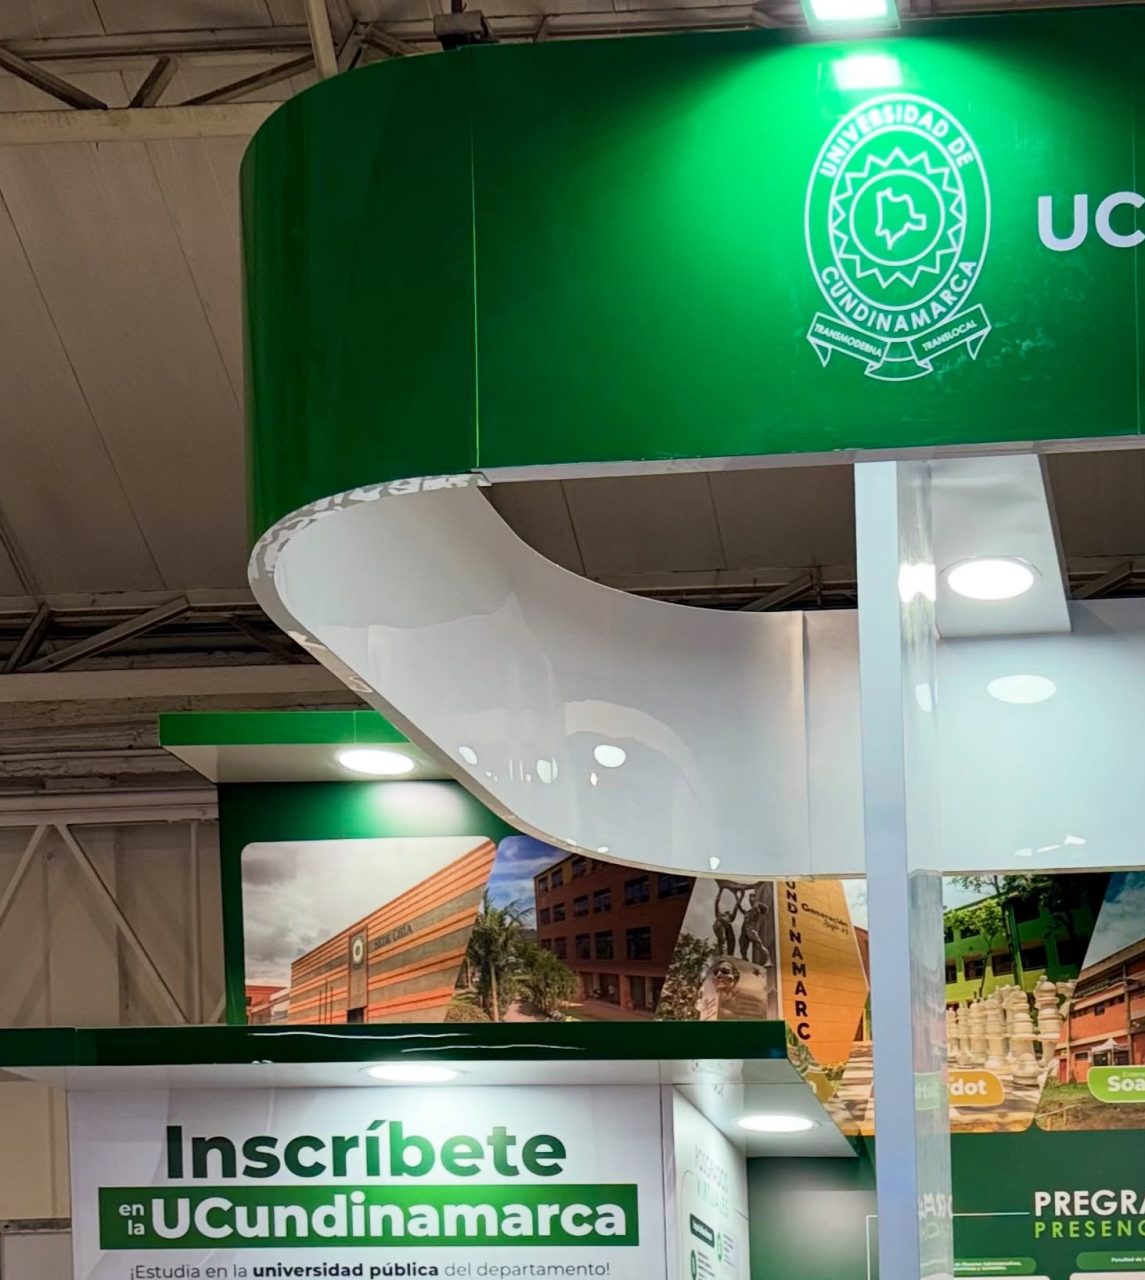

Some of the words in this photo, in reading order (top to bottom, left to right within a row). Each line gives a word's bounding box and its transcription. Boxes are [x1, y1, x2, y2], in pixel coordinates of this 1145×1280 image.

[819, 104, 949, 178] UNIVERSIDAD
[947, 137, 975, 168] DE
[821, 261, 977, 333] CUNDINAMARCA
[813, 323, 883, 358] TRANSMODERNA
[922, 319, 978, 352] TRANSLOCAL
[166, 1120, 567, 1179] Inscríbete
[118, 1203, 144, 1218] en
[127, 1219, 145, 1236] la
[152, 1192, 627, 1240] UCundinamarca
[130, 1264, 201, 1280] ¡Estudia
[206, 1268, 228, 1279] en
[233, 1264, 248, 1279] la
[253, 1263, 364, 1279] universidad
[444, 1262, 472, 1278] del
[476, 1262, 610, 1280] departamento!
